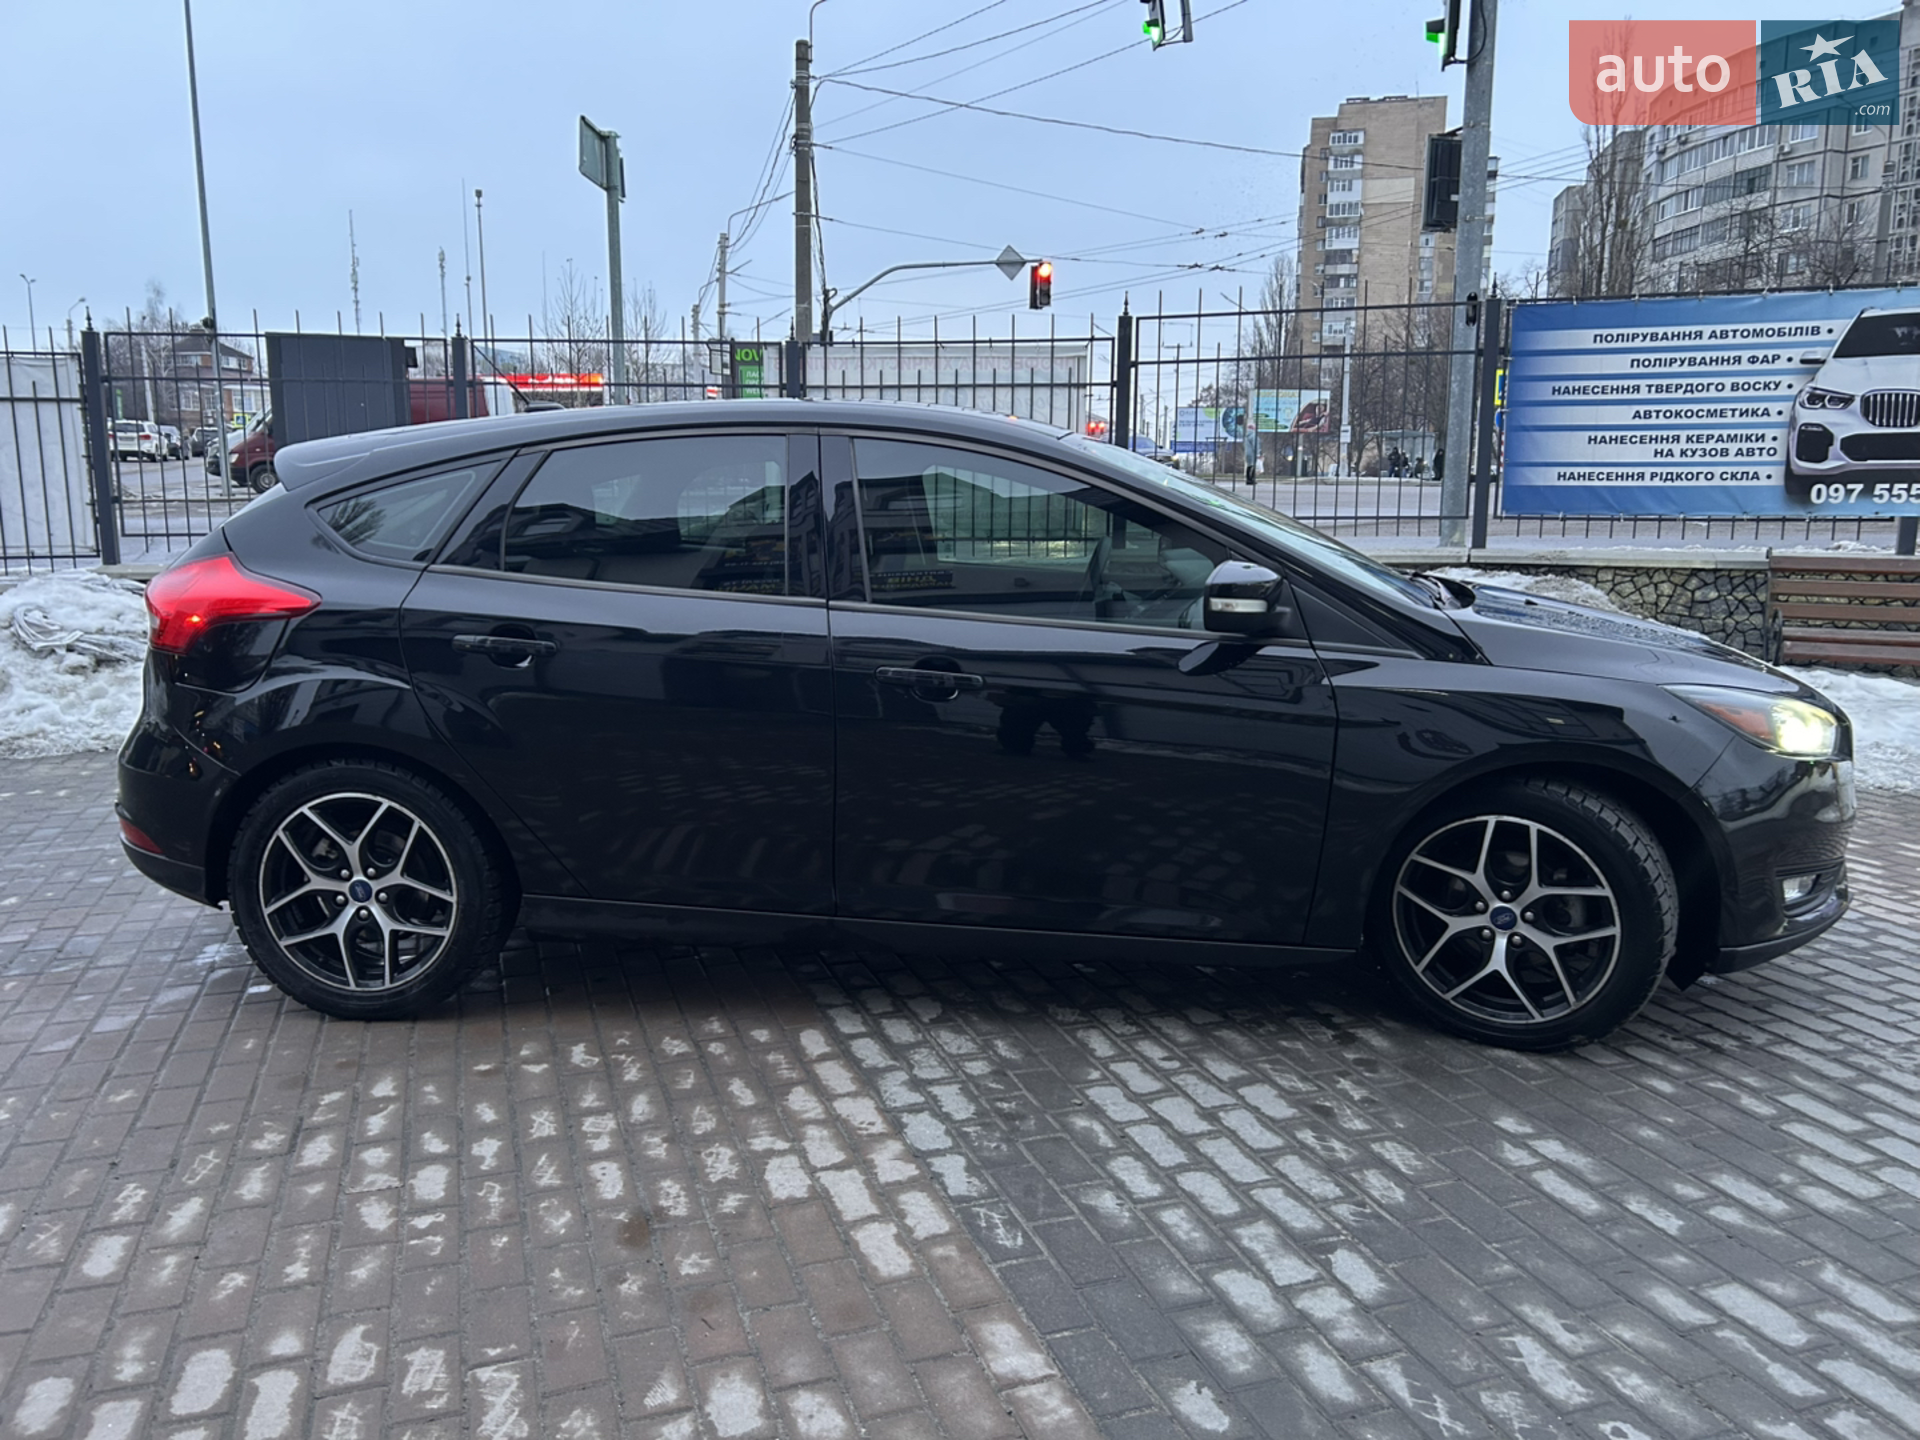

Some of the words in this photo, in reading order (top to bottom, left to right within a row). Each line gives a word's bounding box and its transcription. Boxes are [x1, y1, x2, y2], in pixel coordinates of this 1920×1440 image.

[1593, 330, 1703, 344] ПОЛІРУВАННЯ
[1708, 325, 1821, 340] АВТОМОБІЛІВ
[1630, 355, 1742, 368] ПОЛІРУВАННЯ
[1747, 354, 1781, 365] ФАР
[1552, 384, 1641, 396] НАНЕСЕННЯ
[1645, 382, 1726, 395] ТВЕРДОГО
[1730, 380, 1782, 392] ВОСКУ
[1632, 407, 1771, 420] АВТОКОСМЕТИКА
[1587, 434, 1681, 445] НАНЕСЕННЯ
[1685, 433, 1766, 444] КЕРАМІКИ
[1653, 448, 1675, 458] НА
[1680, 447, 1730, 458] КУЗОВ
[1734, 446, 1778, 457] АВТО
[1557, 471, 1645, 482] НАНЕСЕННЯ
[1650, 471, 1715, 483] РІДКОГО
[1719, 471, 1761, 481] СКЛА
[1810, 483, 1864, 504] 097
[1872, 483, 1920, 504] 555
